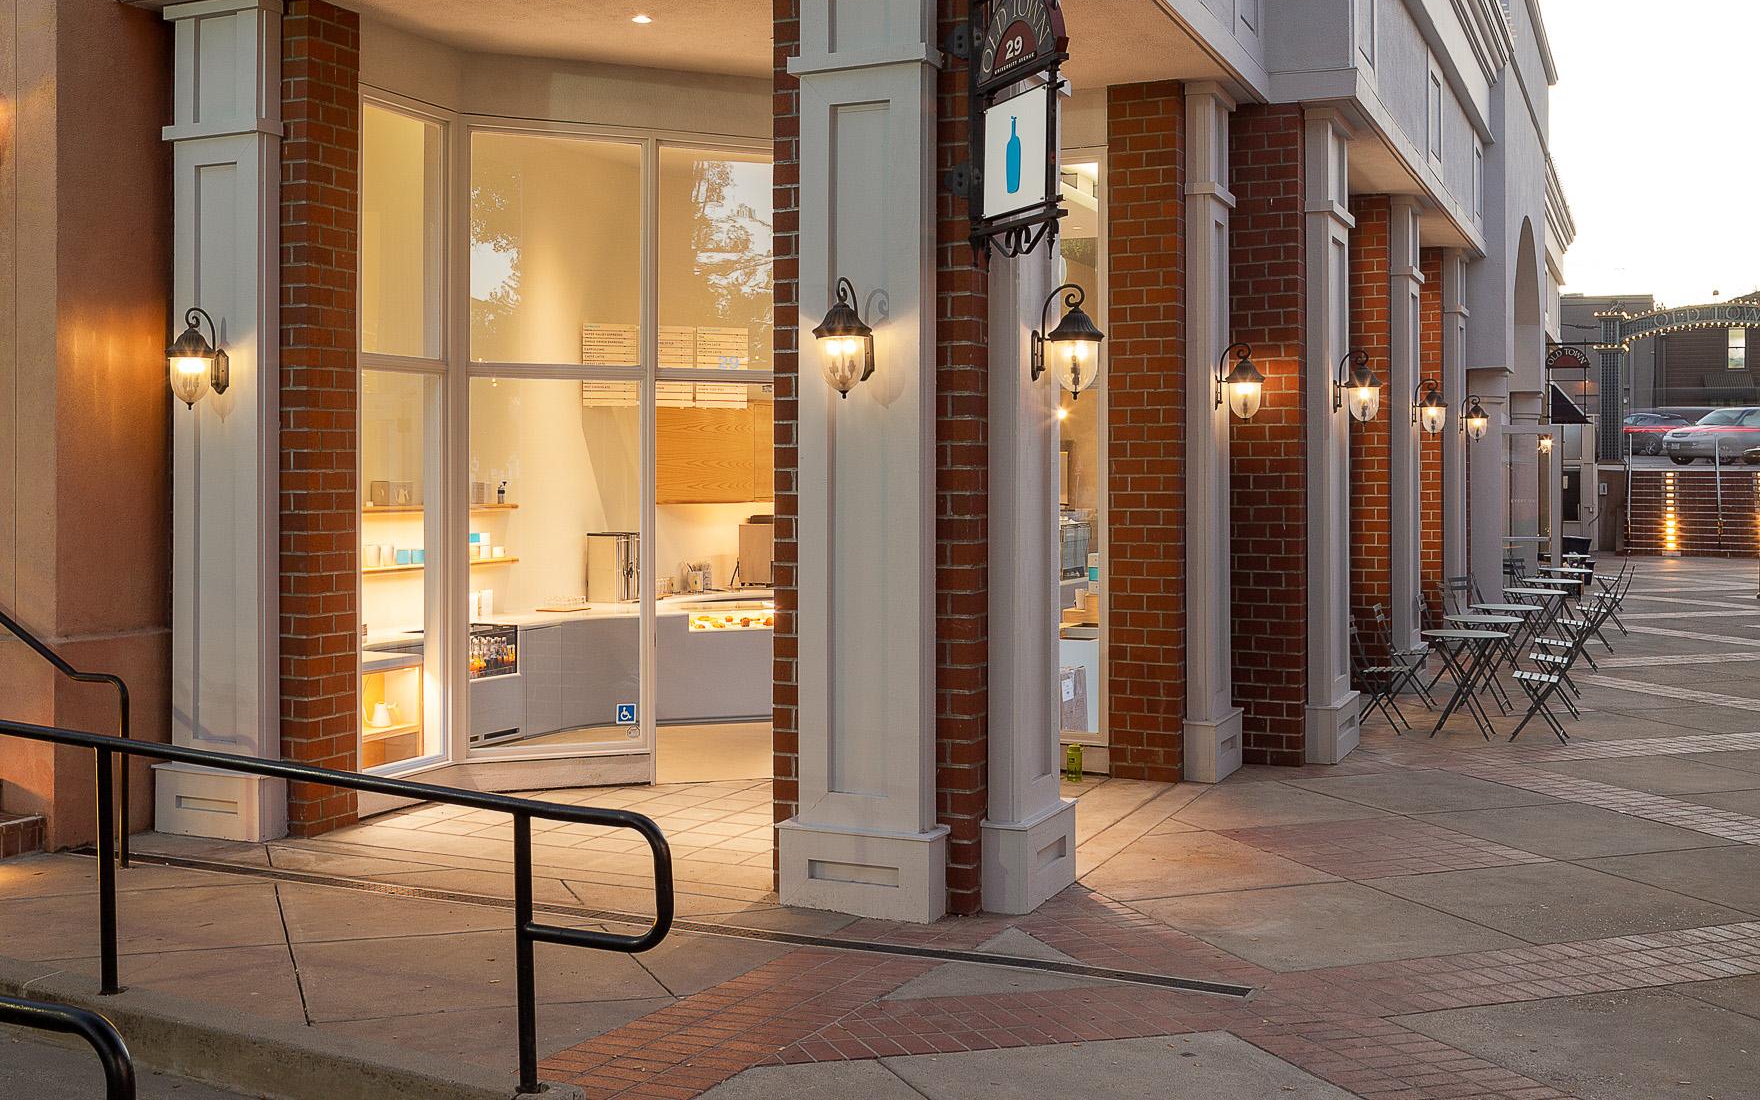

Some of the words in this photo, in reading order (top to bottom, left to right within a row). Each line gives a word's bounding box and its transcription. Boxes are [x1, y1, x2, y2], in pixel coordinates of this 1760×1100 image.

[982, 8, 1007, 74] OLD
[1005, 35, 1023, 60] 29
[1653, 308, 1701, 327] OLD
[718, 356, 739, 370] 29
[1547, 350, 1562, 365] OLD
[1564, 349, 1587, 364] TOWN
